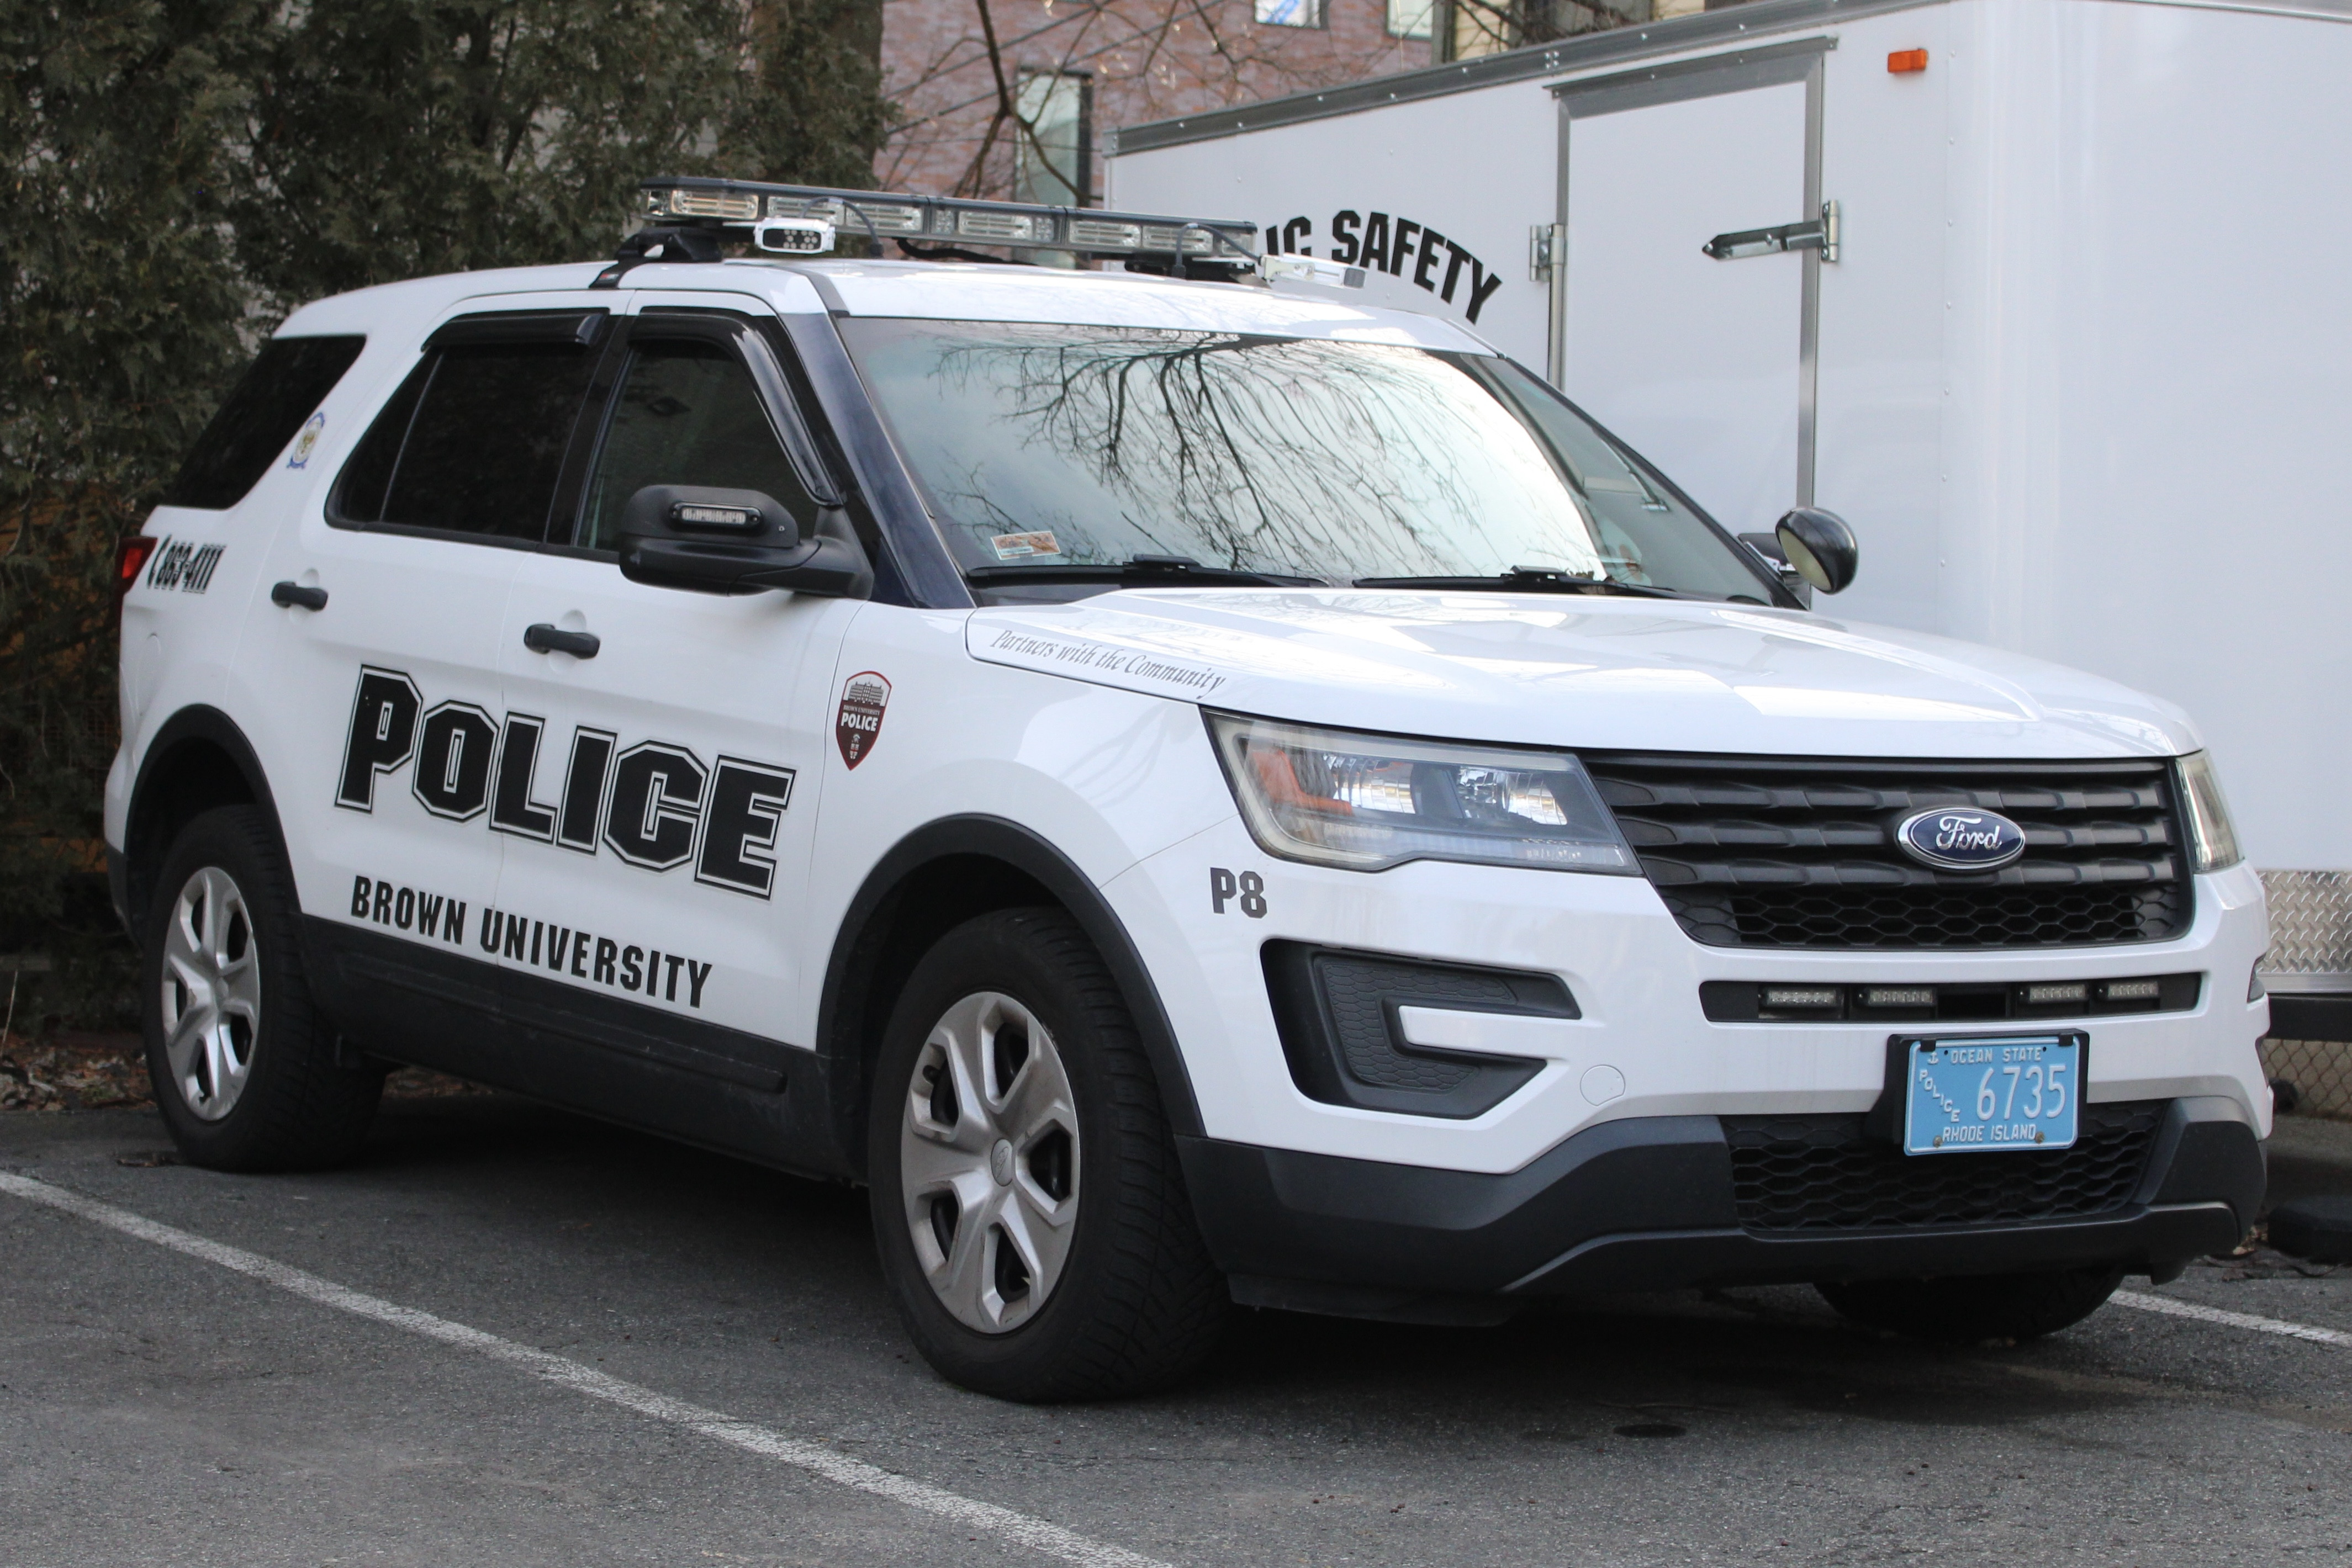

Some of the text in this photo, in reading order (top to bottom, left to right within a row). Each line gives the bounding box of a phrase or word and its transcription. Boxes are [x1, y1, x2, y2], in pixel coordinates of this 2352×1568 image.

[1331, 210, 1503, 325] SAFETY
[990, 630, 1226, 700] Partners with the Community
[841, 712, 879, 732] POLICE
[334, 664, 797, 900] POLICE
[1936, 816, 2002, 850] Ford
[1210, 867, 1267, 919] P8
[351, 875, 712, 1009] BROWN UNIVERSITY
[1951, 1048, 2042, 1064] OCEAN STATE
[1919, 1068, 1960, 1123] POLICE
[1976, 1063, 2066, 1121] 6735
[1942, 1124, 2037, 1142] RHODE ISLAND
